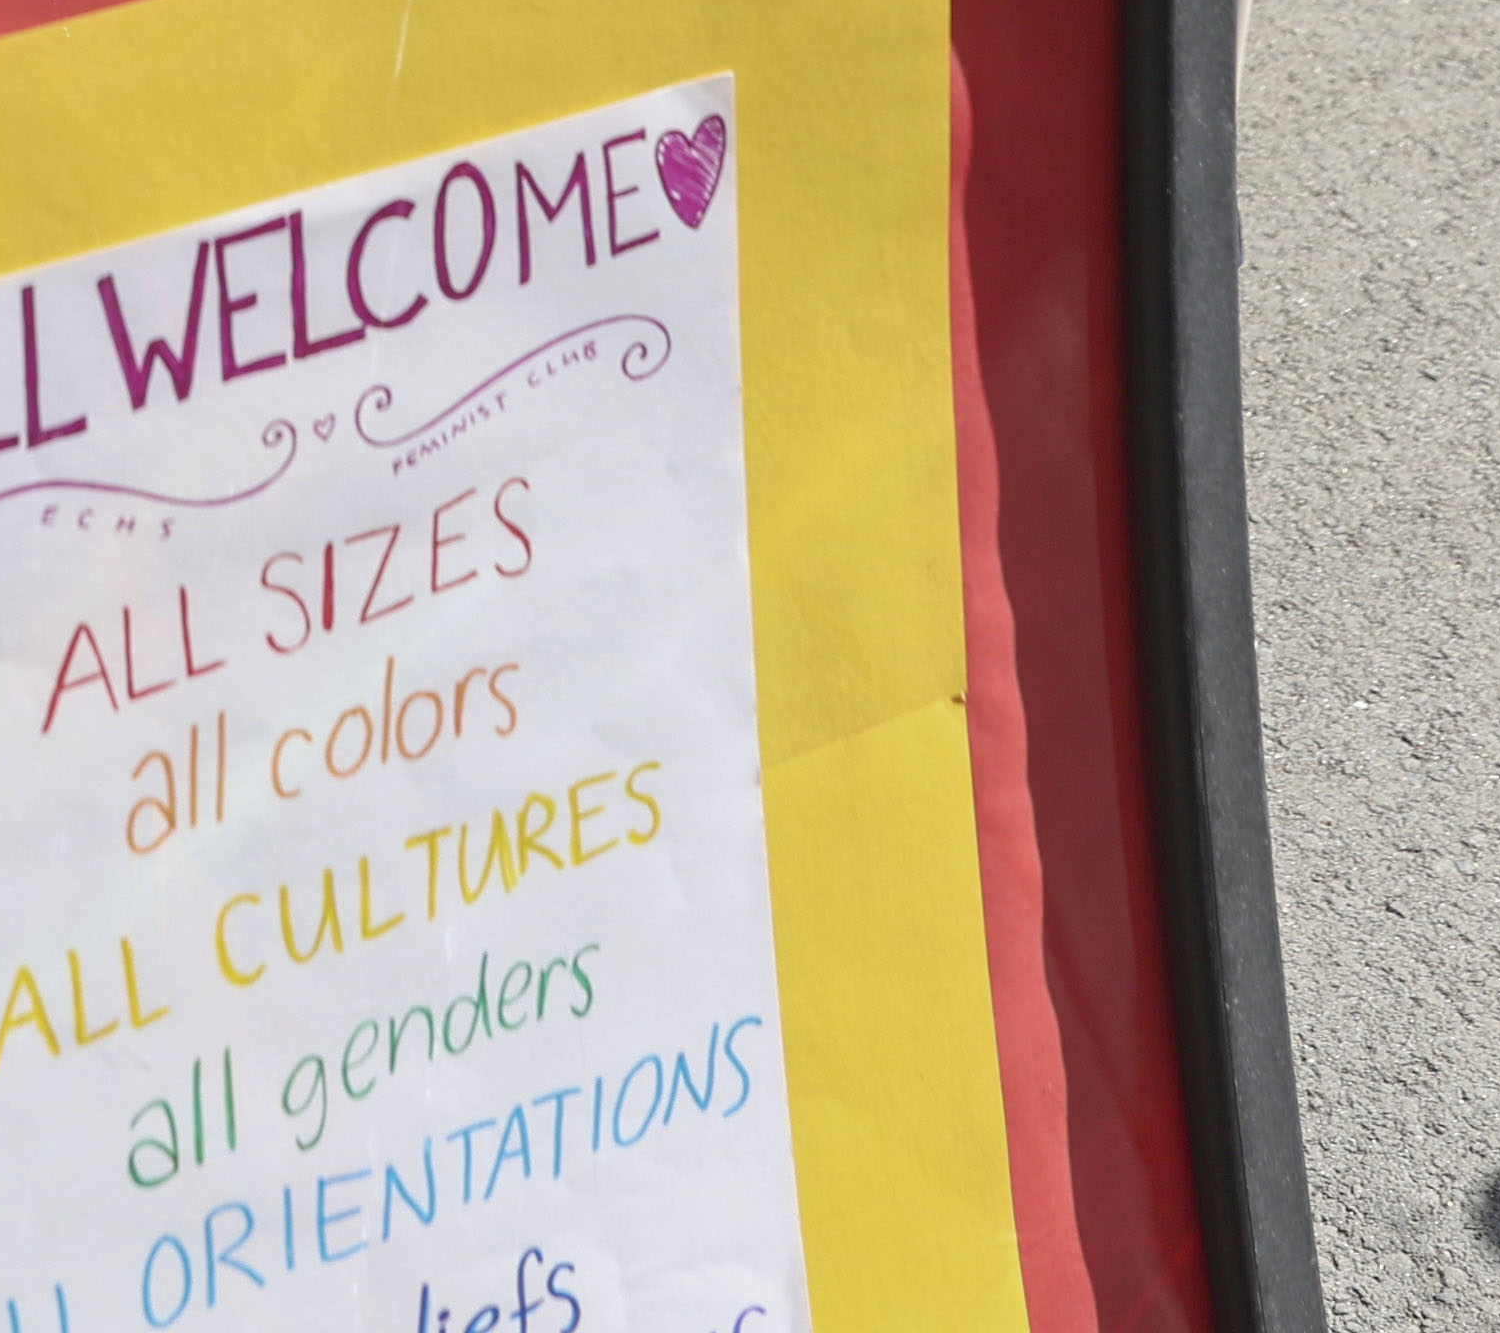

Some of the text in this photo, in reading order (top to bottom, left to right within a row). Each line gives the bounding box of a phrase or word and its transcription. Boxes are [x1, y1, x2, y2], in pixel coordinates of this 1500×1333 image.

[96, 128, 658, 411] WELCOME
[391, 392, 506, 476] FEMINIST
[526, 339, 599, 389] CLUB
[41, 477, 535, 733] ALL SIZES
[124, 658, 521, 854] all colors
[213, 761, 664, 989] CULTURES
[126, 944, 602, 1188] all genders
[142, 1017, 764, 1329] ORIENTATIONS
